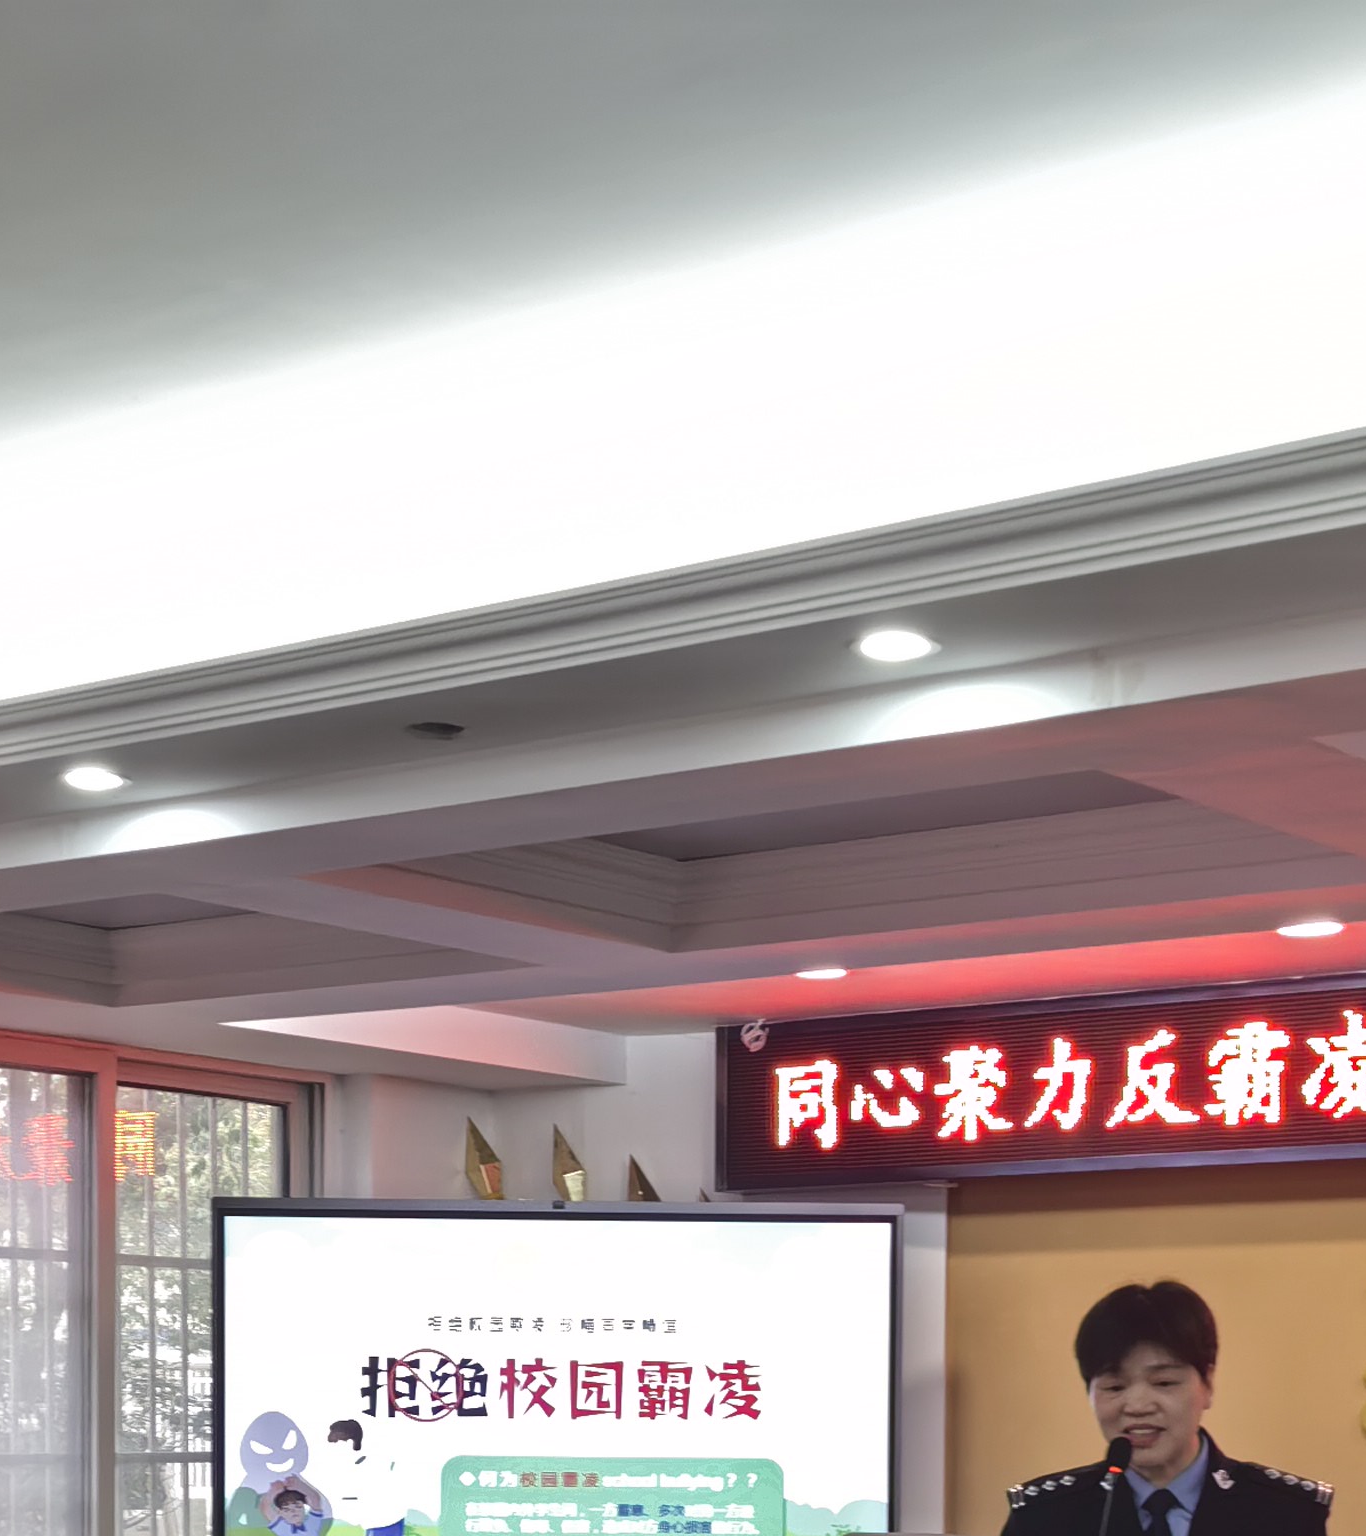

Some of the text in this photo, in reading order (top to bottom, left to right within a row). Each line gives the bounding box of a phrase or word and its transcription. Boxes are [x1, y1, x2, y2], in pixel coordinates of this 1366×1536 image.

[361, 1355, 763, 1421] 拒绝校园霸凌
